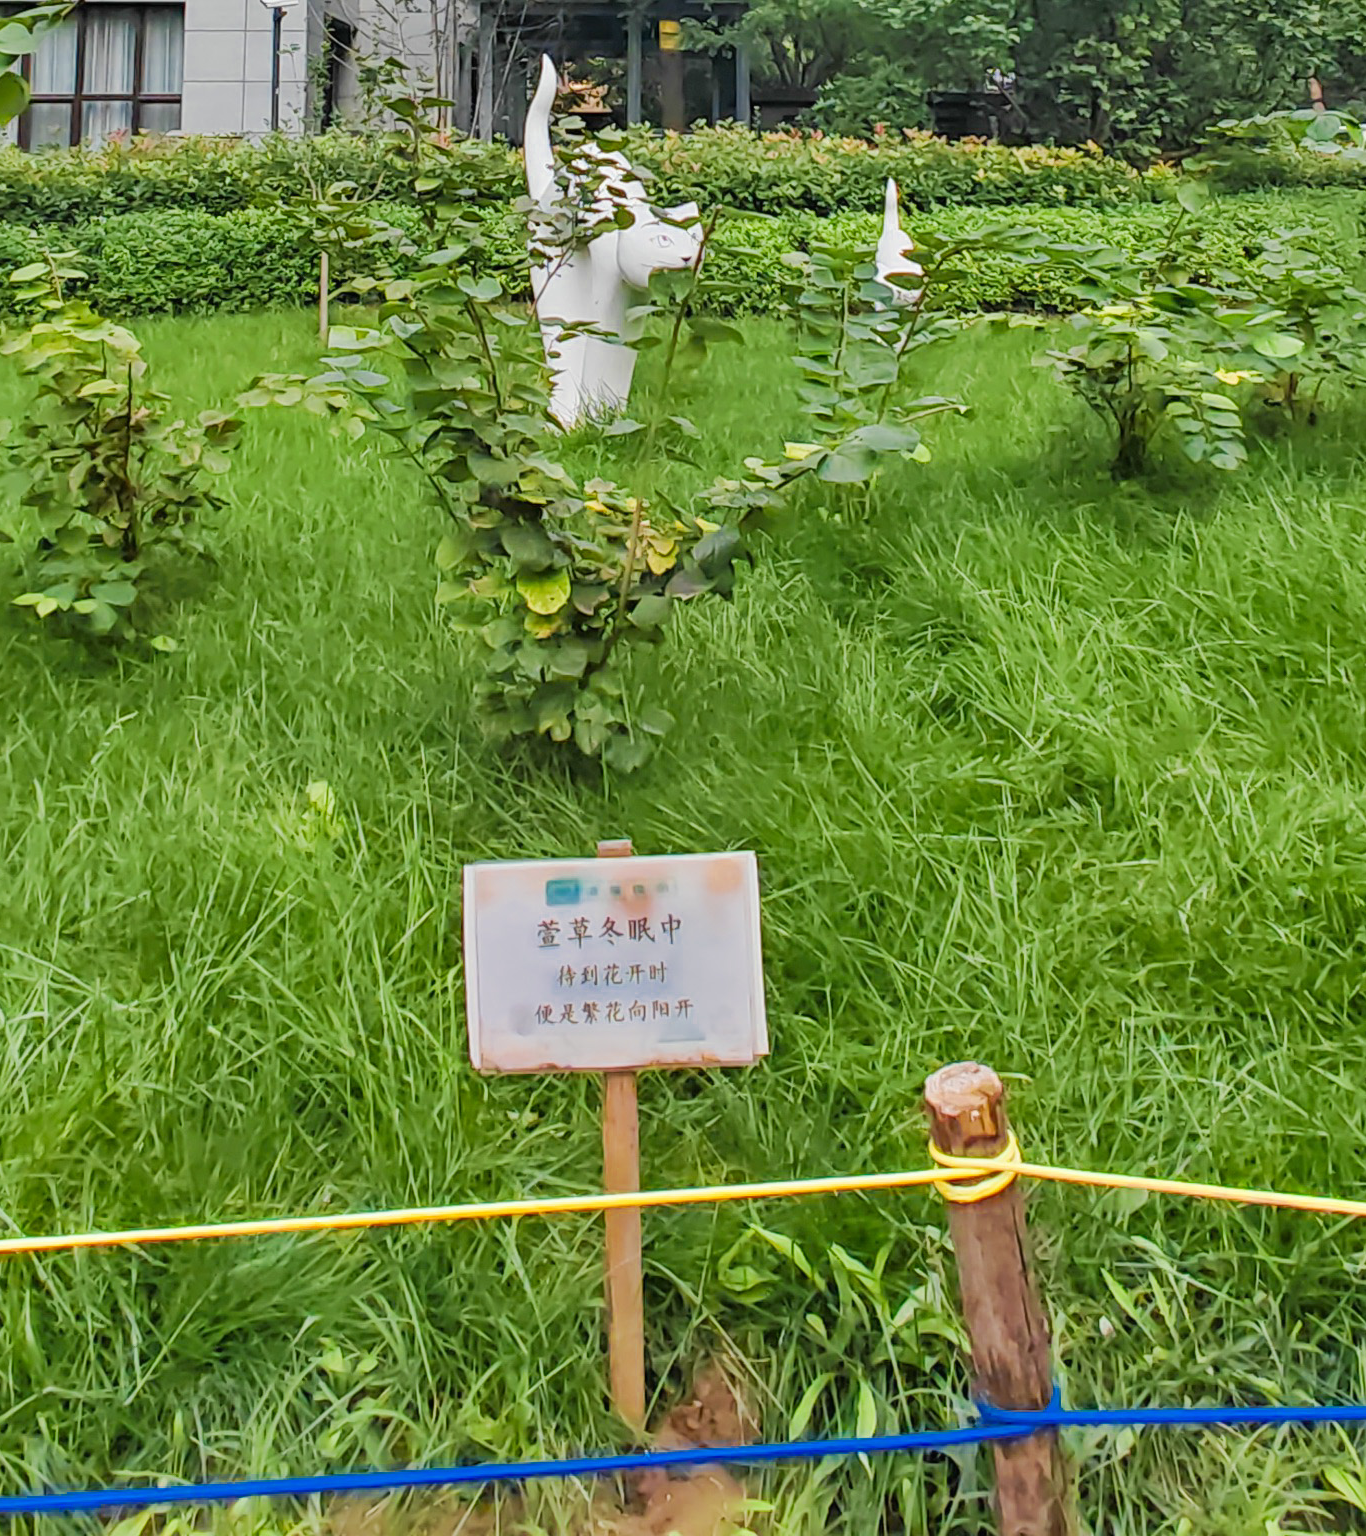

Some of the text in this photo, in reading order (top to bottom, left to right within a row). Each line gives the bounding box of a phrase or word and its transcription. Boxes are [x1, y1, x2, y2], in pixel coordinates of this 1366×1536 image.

[537, 913, 681, 949] 萱草冬眠中
[557, 961, 667, 987] 待到花开时
[534, 998, 694, 1025] 便是繁花向阳开
